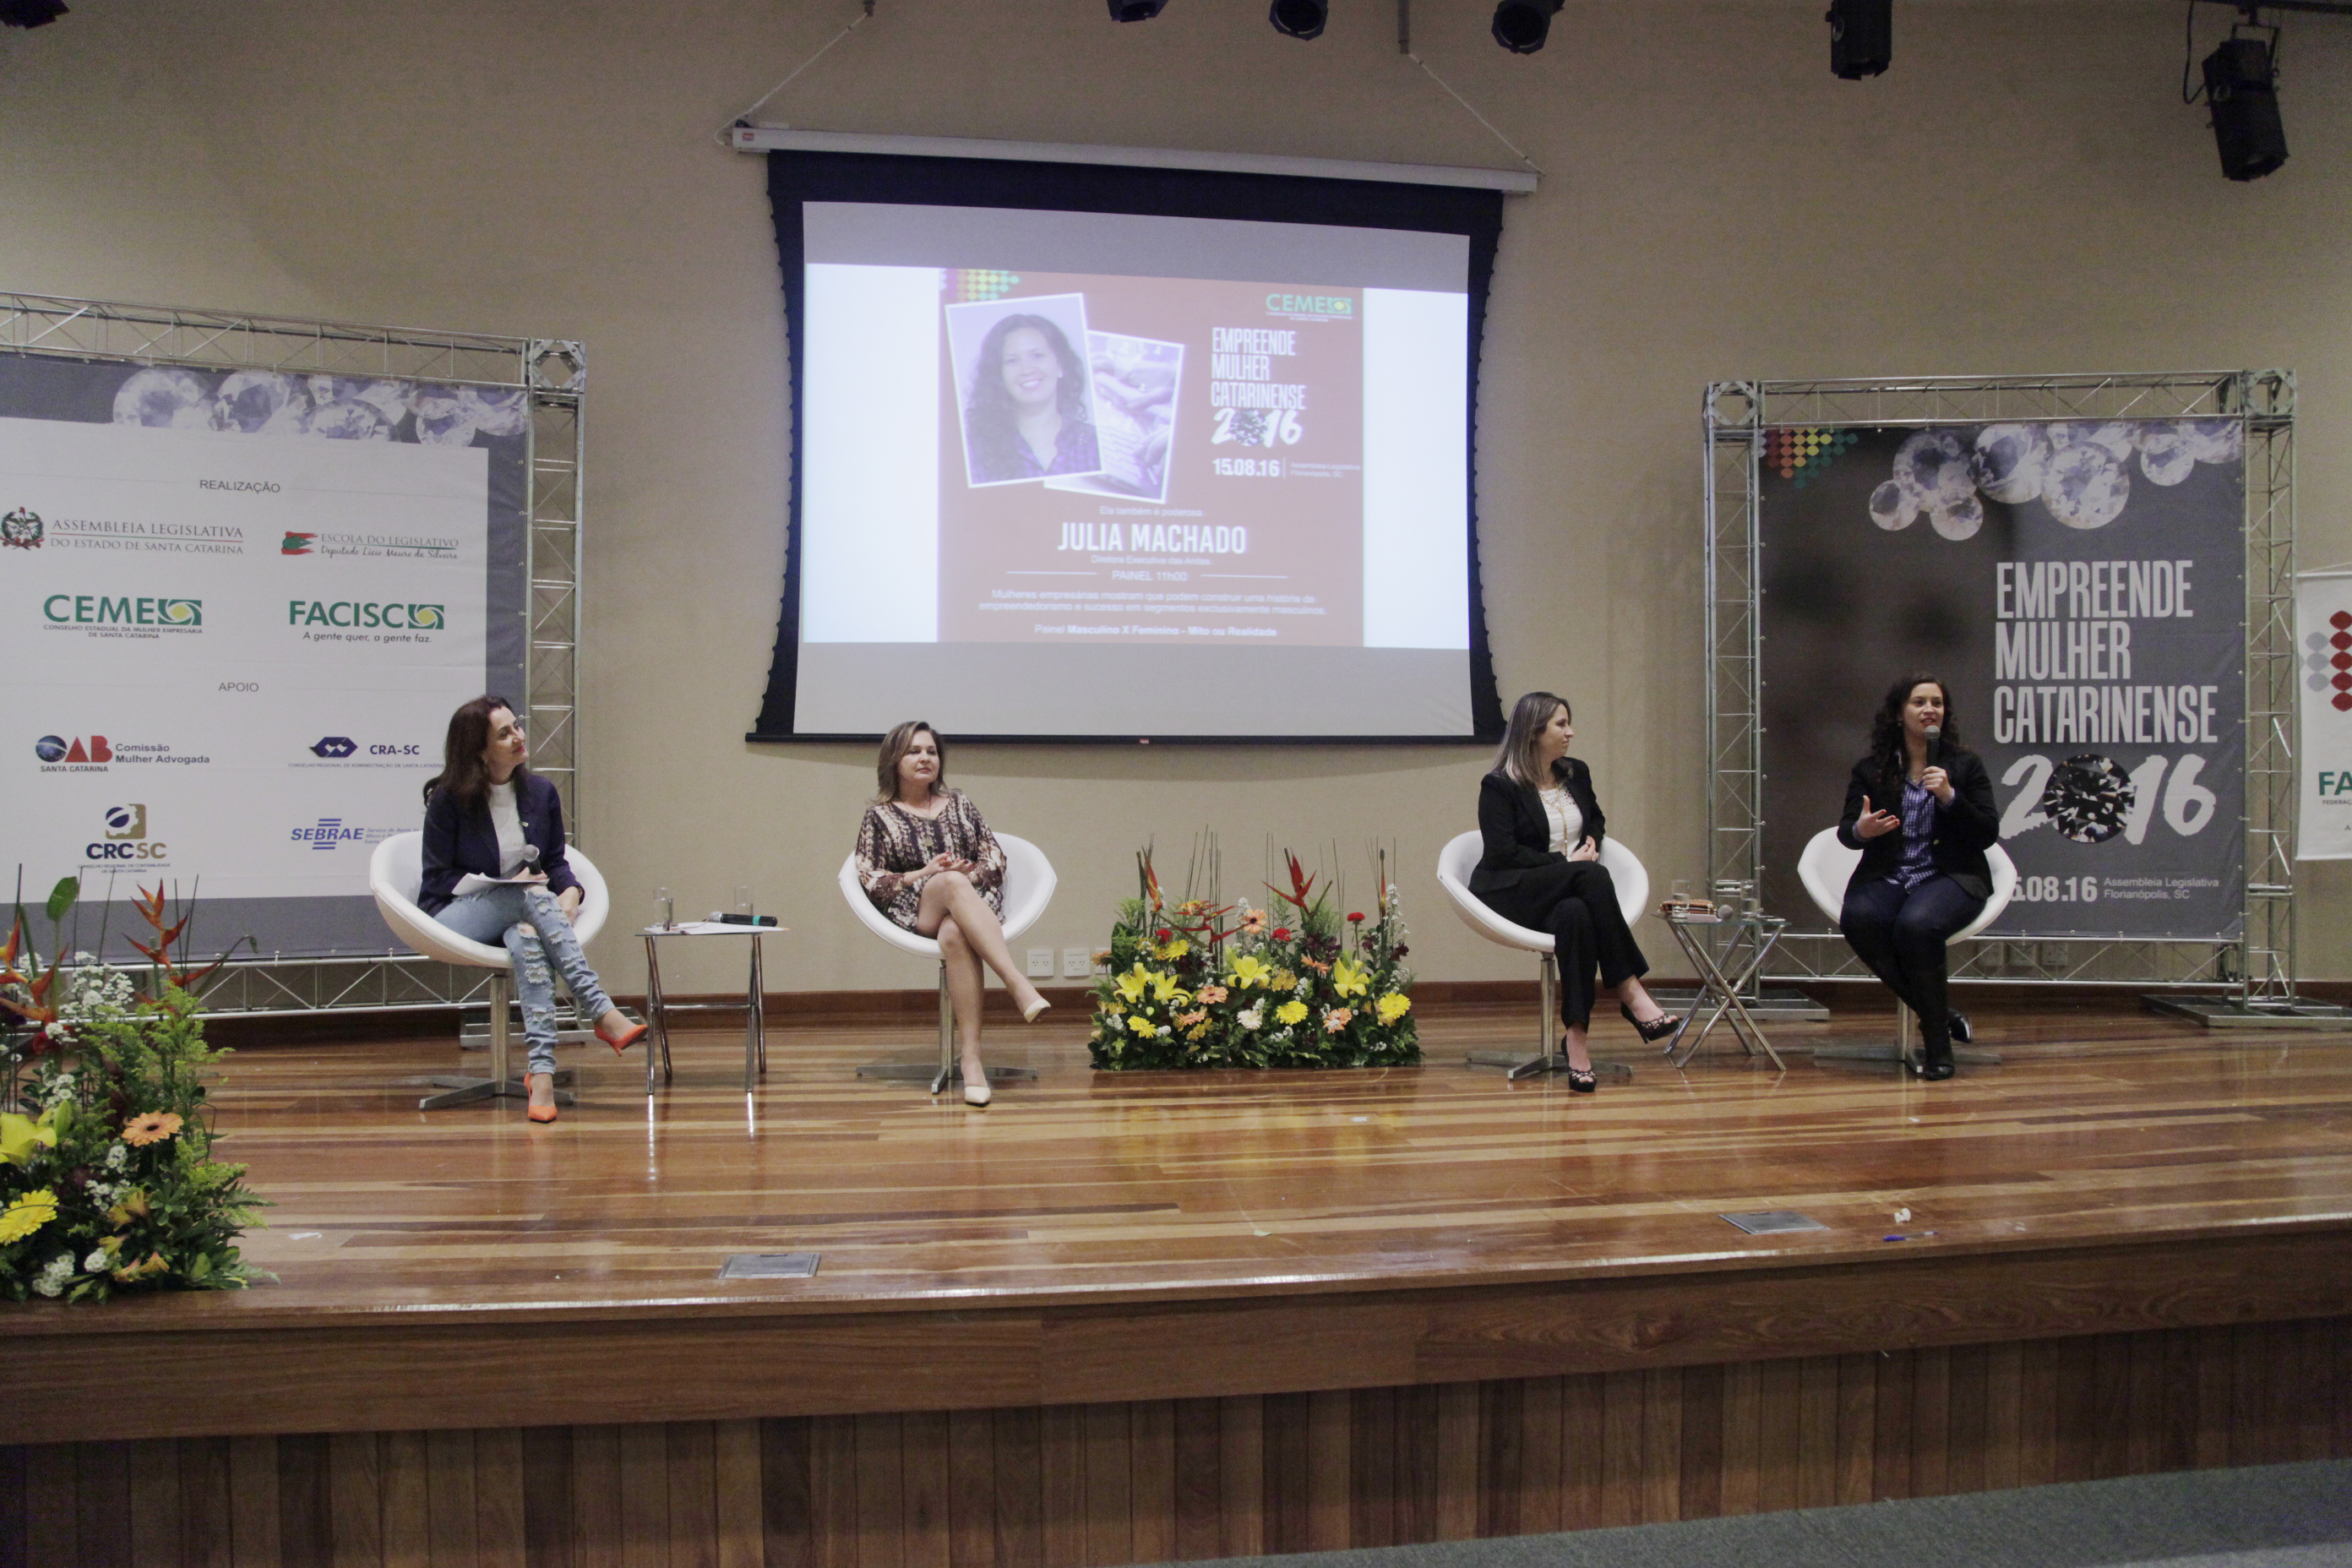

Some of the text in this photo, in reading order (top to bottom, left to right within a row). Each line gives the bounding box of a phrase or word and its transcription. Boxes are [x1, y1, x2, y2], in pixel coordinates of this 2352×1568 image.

[1266, 293, 1326, 313] CEME
[1212, 327, 1297, 356] EMPREENDE
[1211, 353, 1271, 381] MULHER
[1211, 380, 1307, 411] CATARINENSE
[1211, 458, 1281, 477] 15.08.16
[199, 479, 280, 494] REALIZAÇÃO
[1099, 506, 1114, 514] Ela
[1116, 507, 1152, 515] também
[52, 520, 243, 538] ASSEMBLEIA LEGISLATIVA
[321, 534, 459, 547] ESCOLA DO LEGISLATIVO
[1057, 522, 1247, 554] JULIA MACHADO
[51, 537, 243, 554] DO ESTADO DE SANTA CATARINA
[320, 545, 359, 558] Deputado
[385, 547, 411, 557] Mauro
[414, 548, 425, 558] da
[427, 548, 459, 559] Silveira
[1091, 555, 1124, 564] Diretora
[1125, 556, 1166, 564] Executiva
[1168, 557, 1183, 565] das
[1112, 570, 1188, 581] PAINEL 11h00
[1995, 559, 2194, 618] EMPREENDE
[992, 590, 1037, 599] Mulheres
[1039, 591, 1099, 601] empresárias
[1146, 593, 1164, 602] que
[1166, 592, 1199, 602] podem
[1200, 593, 1242, 602] construir
[1267, 595, 1301, 603] história
[44, 594, 155, 624] CEME
[289, 601, 404, 629] FACISC
[978, 602, 1073, 612] empreendedorismo
[1083, 603, 1124, 612] sucesso
[1143, 604, 1195, 614] segmentos
[1197, 604, 1271, 613] exclusivamente
[1034, 624, 1064, 634] Painel
[1067, 624, 1120, 634] Masculino
[1122, 625, 1130, 634] X
[1132, 625, 1179, 635] Feminino
[1188, 626, 1210, 635] Mito
[1228, 627, 1277, 636] Realidade
[313, 633, 342, 642] gente
[383, 634, 411, 644] gente
[414, 634, 432, 643] faz.
[1995, 620, 2132, 681] MULHER
[218, 682, 259, 693] APOIO
[1993, 684, 2219, 743] CATARINENSE
[35, 735, 113, 763] OAB
[116, 743, 170, 752] Comissão
[369, 744, 420, 755] CRA-SC
[115, 754, 210, 765] Mulher Advogada
[291, 828, 364, 841] SEBRAE
[2104, 877, 2219, 888] Assembleia Legislativa
[2104, 890, 2191, 901] Florianópolis, SC
